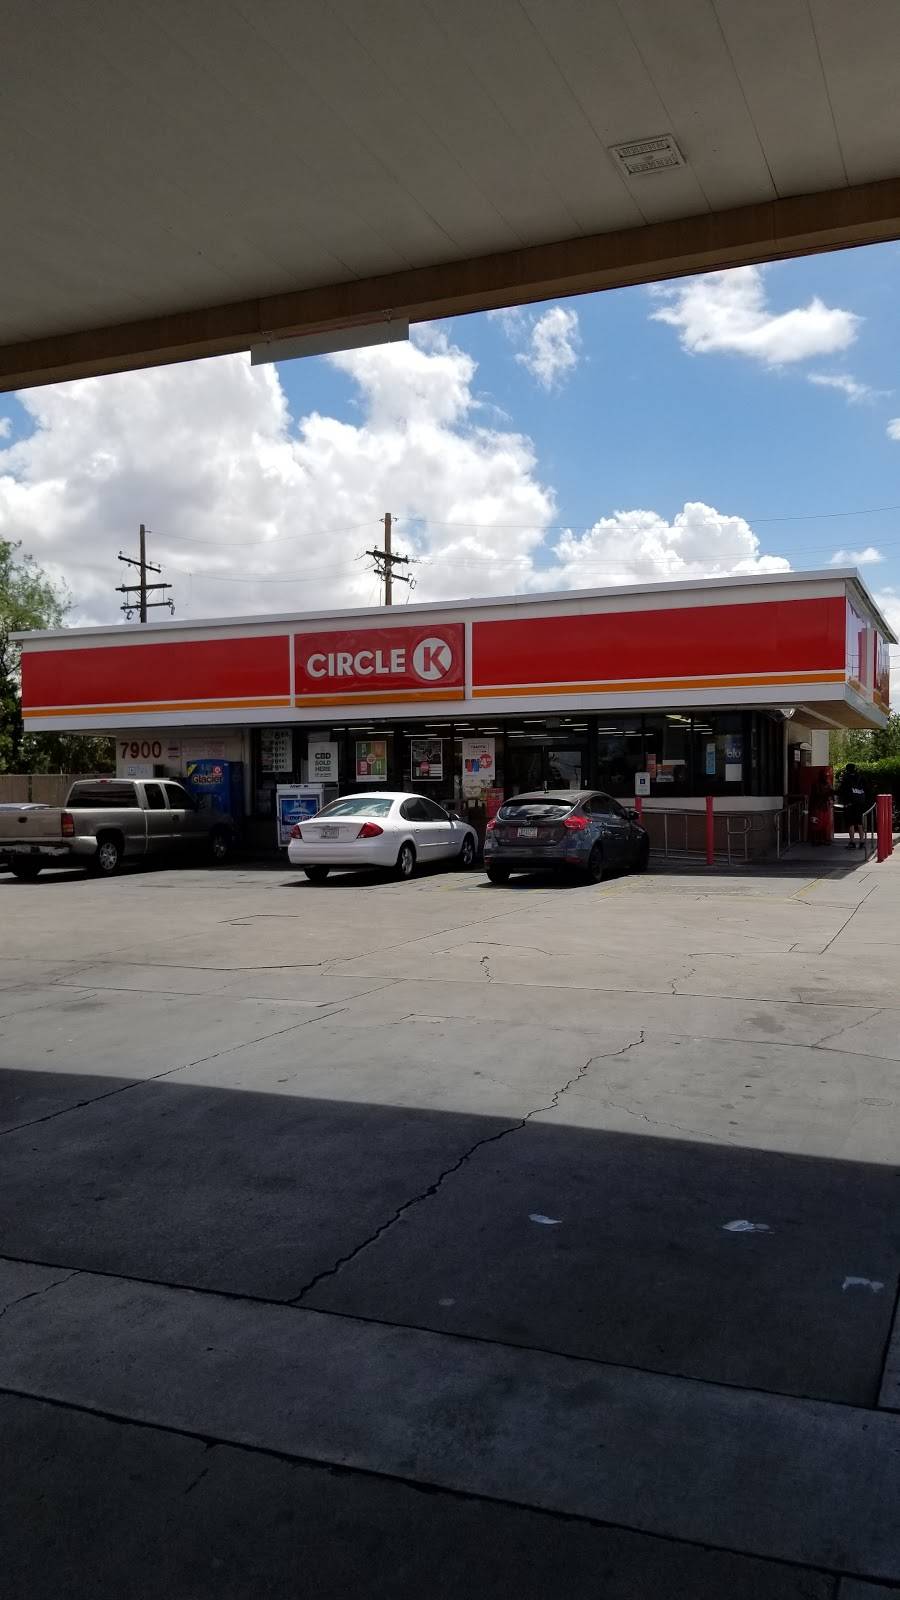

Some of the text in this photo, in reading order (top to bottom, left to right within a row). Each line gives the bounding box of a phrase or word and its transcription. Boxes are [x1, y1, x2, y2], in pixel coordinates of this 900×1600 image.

[307, 644, 449, 679] CIRCLE K
[120, 740, 162, 759] 7900
[314, 752, 332, 760] CBD
